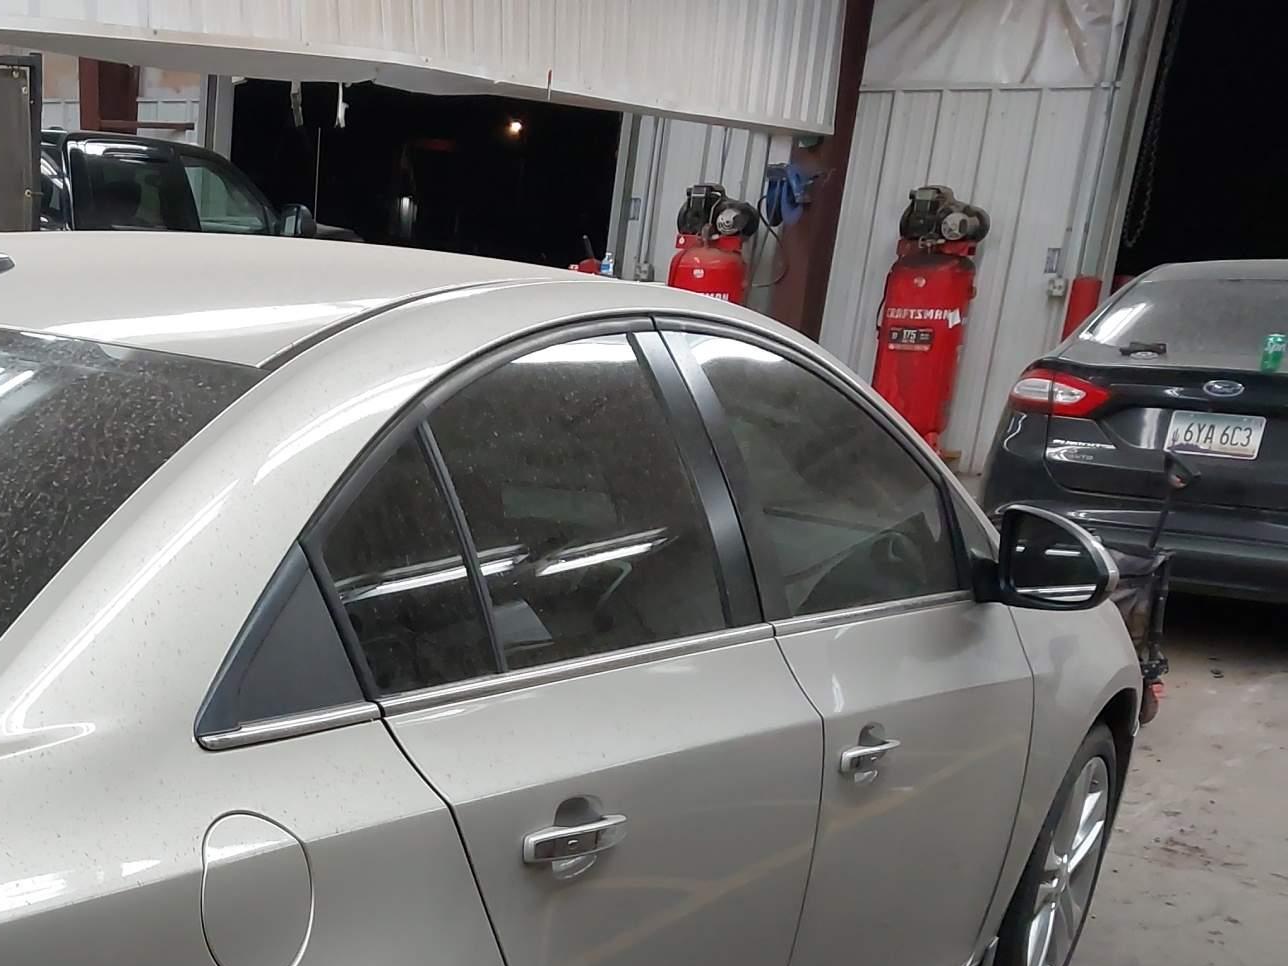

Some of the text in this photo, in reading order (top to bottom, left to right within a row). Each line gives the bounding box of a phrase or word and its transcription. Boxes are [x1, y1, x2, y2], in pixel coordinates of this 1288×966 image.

[903, 329, 917, 340] 175
[1183, 422, 1253, 447] 6YA 6C3
